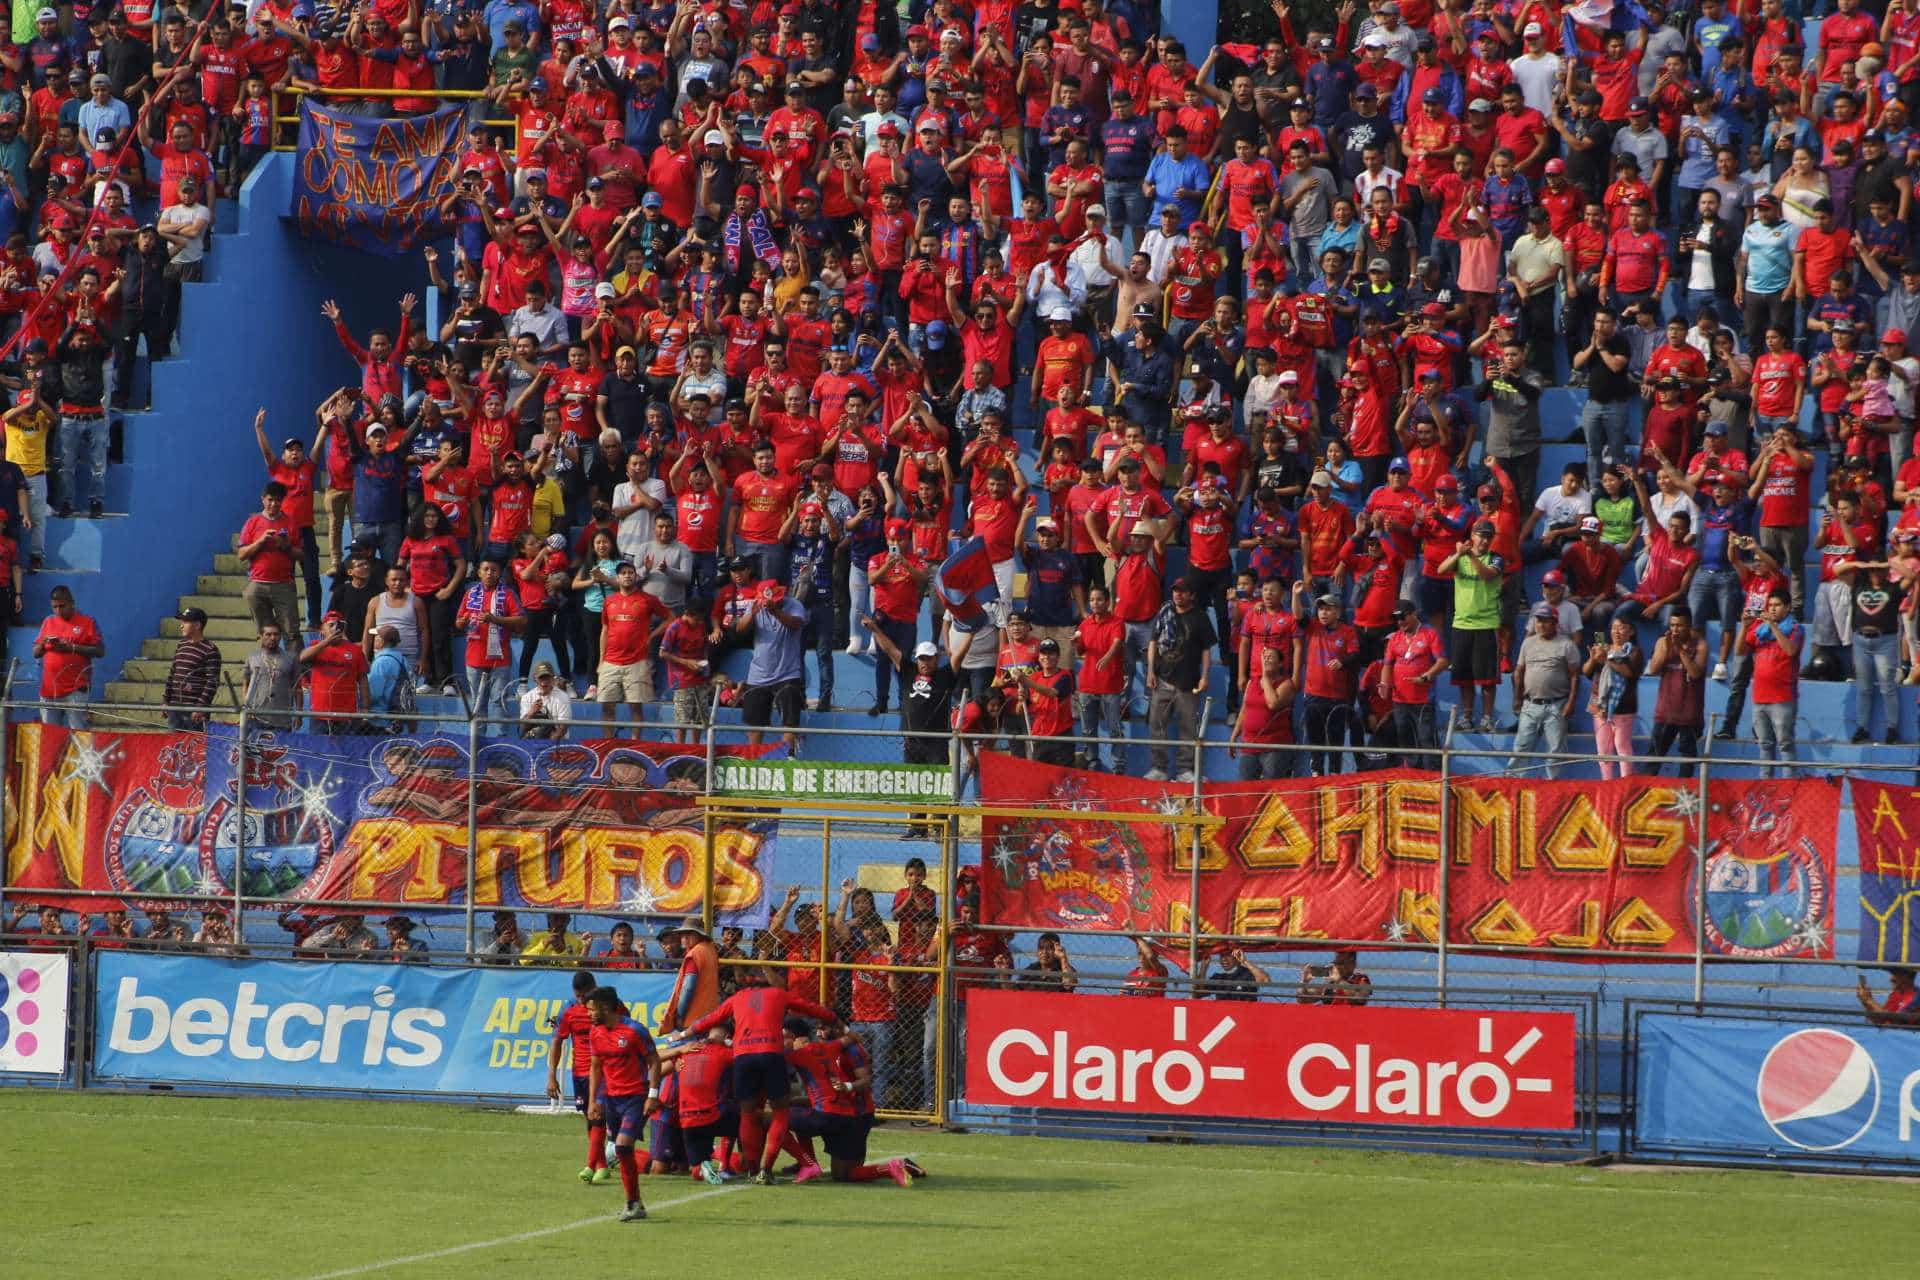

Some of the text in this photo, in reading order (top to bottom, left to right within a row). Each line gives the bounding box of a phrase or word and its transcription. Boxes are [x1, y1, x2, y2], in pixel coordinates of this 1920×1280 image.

[310, 108, 466, 160] TE AMO
[303, 147, 423, 206] COMO
[713, 766, 954, 797] SALIDA DE EMERGENCIA
[345, 815, 765, 912] PITUFOS
[1170, 895, 1330, 948] DEL
[109, 974, 448, 1068] betcris
[986, 1030, 1206, 1107] Claro
[1286, 1042, 1511, 1119] Claro
